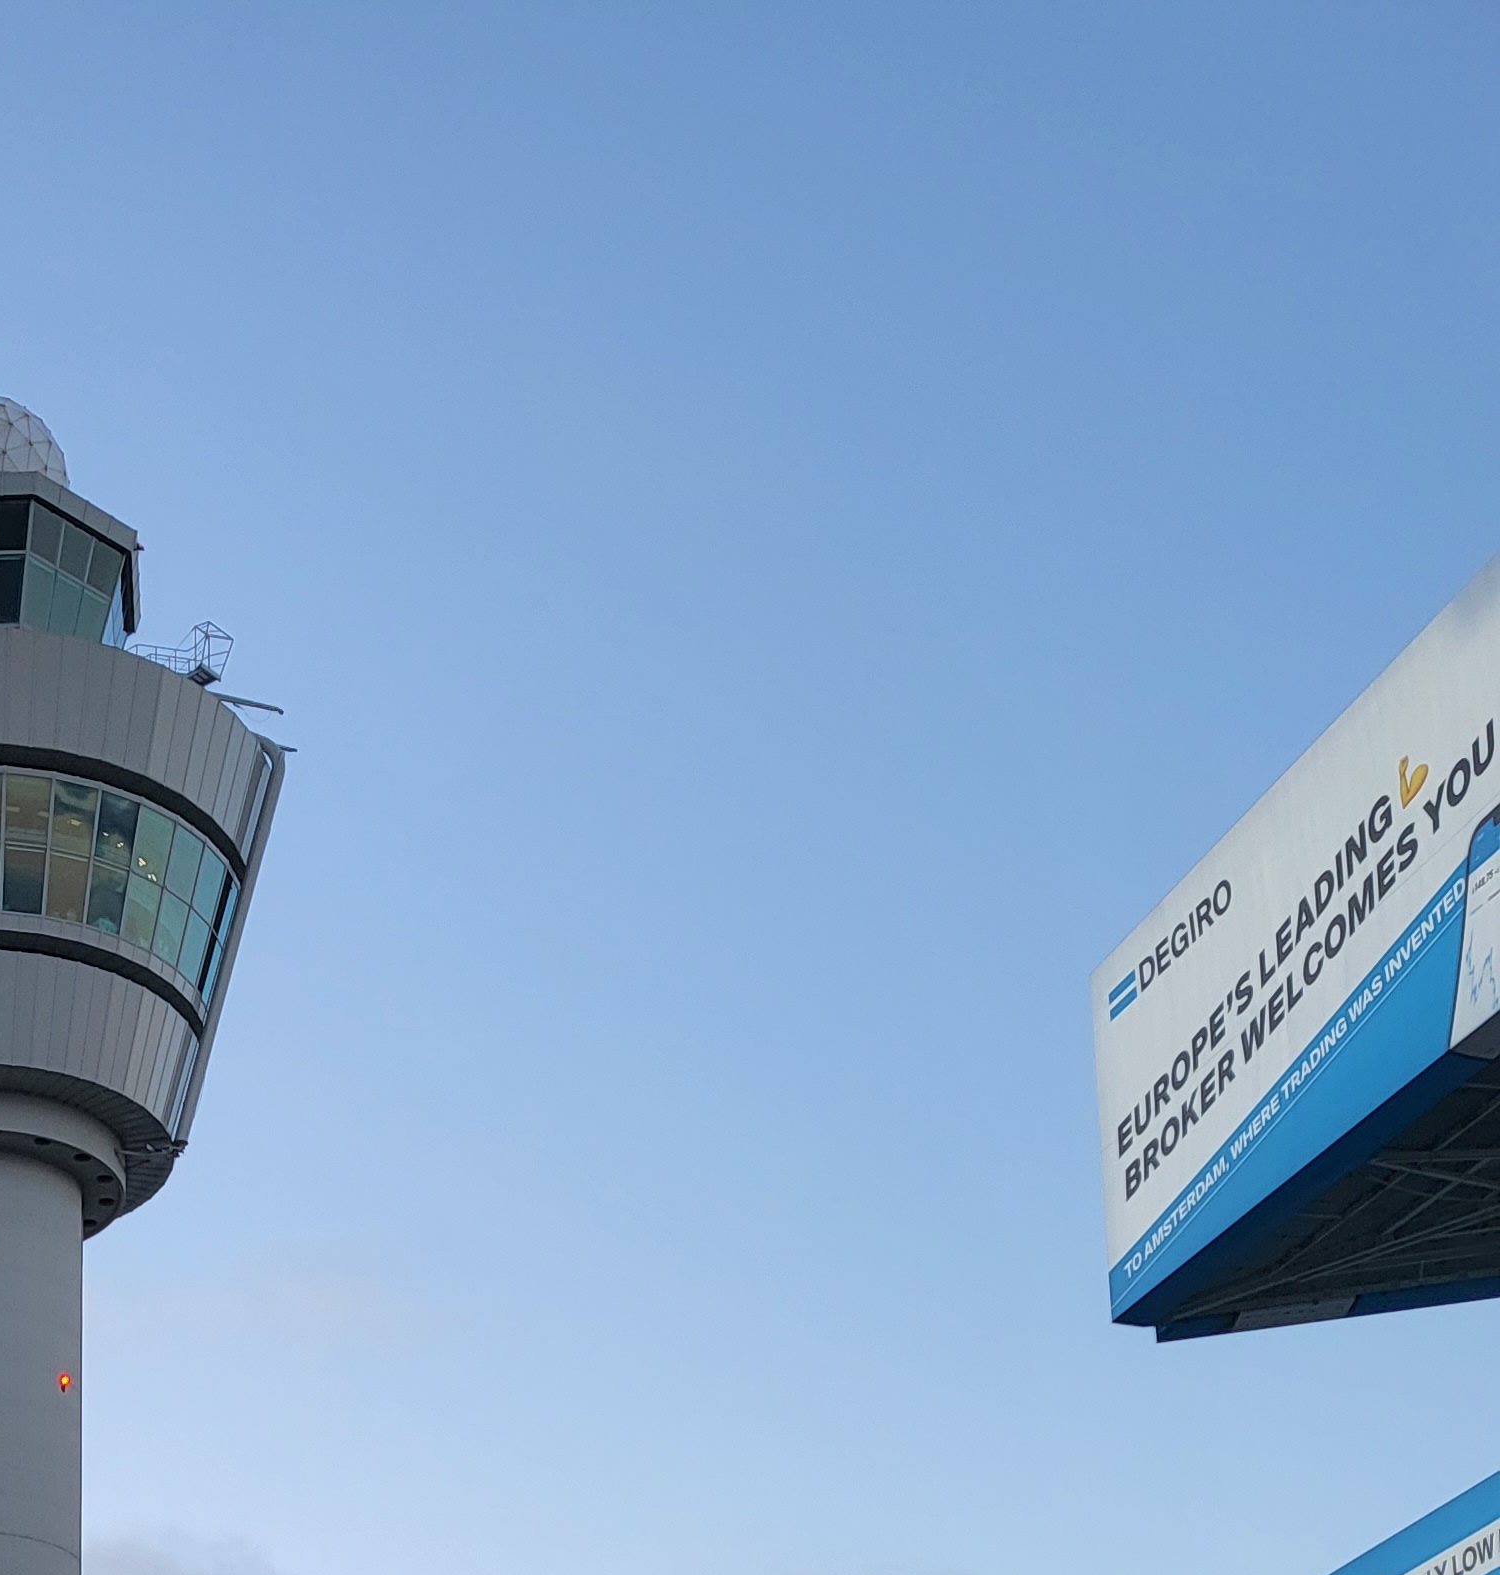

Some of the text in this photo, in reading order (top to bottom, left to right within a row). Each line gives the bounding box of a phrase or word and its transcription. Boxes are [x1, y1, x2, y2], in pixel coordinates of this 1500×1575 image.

[1117, 795, 1393, 1159] EUROPE'S LEADING
[1124, 877, 1466, 1278] TO AMSTERDAM, WHERE TRADING WAS INVENTED
[1125, 718, 1496, 1202] BROKER WELCOMES YOU
[1138, 880, 1232, 993] DEGIRO
